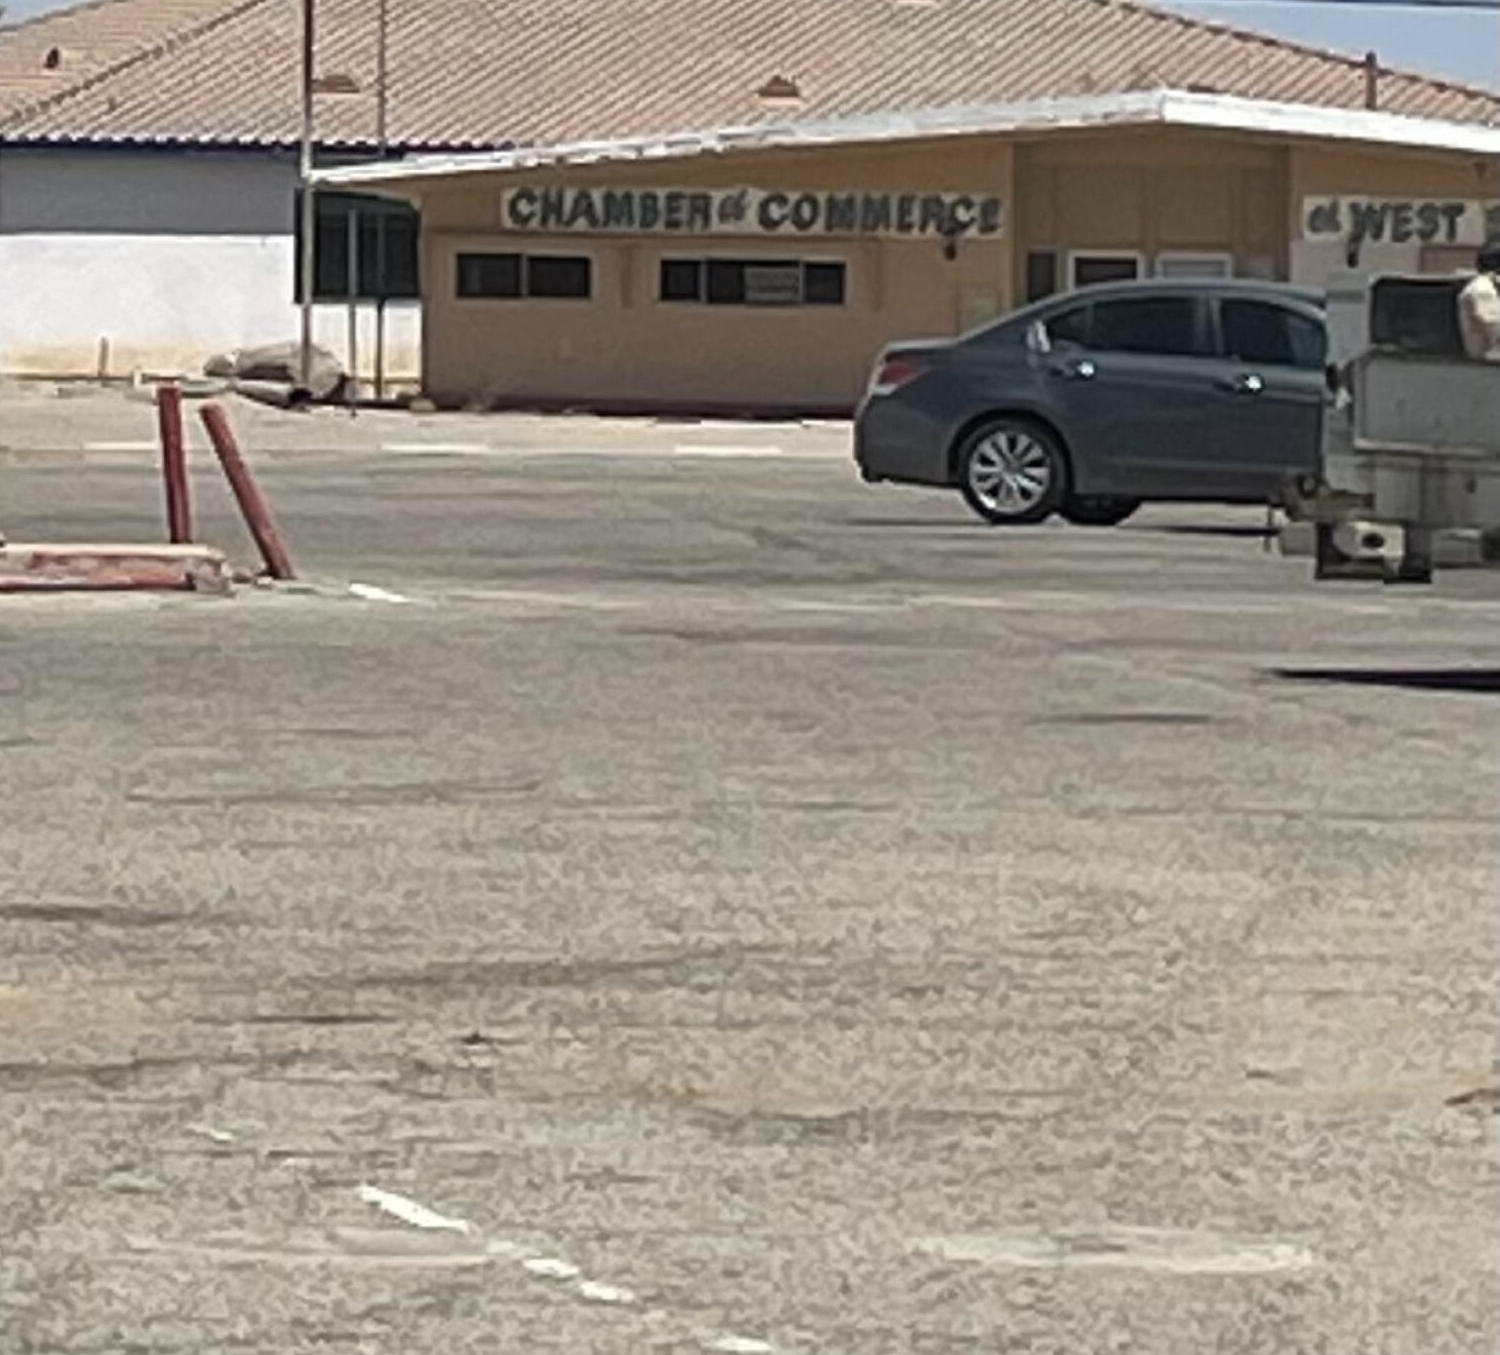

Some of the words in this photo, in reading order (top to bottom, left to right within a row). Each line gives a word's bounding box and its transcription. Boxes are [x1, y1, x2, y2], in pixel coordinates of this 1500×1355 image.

[508, 187, 713, 231] CHAMBER
[757, 194, 1002, 235] COMMERCE
[1349, 202, 1465, 243] WEST
